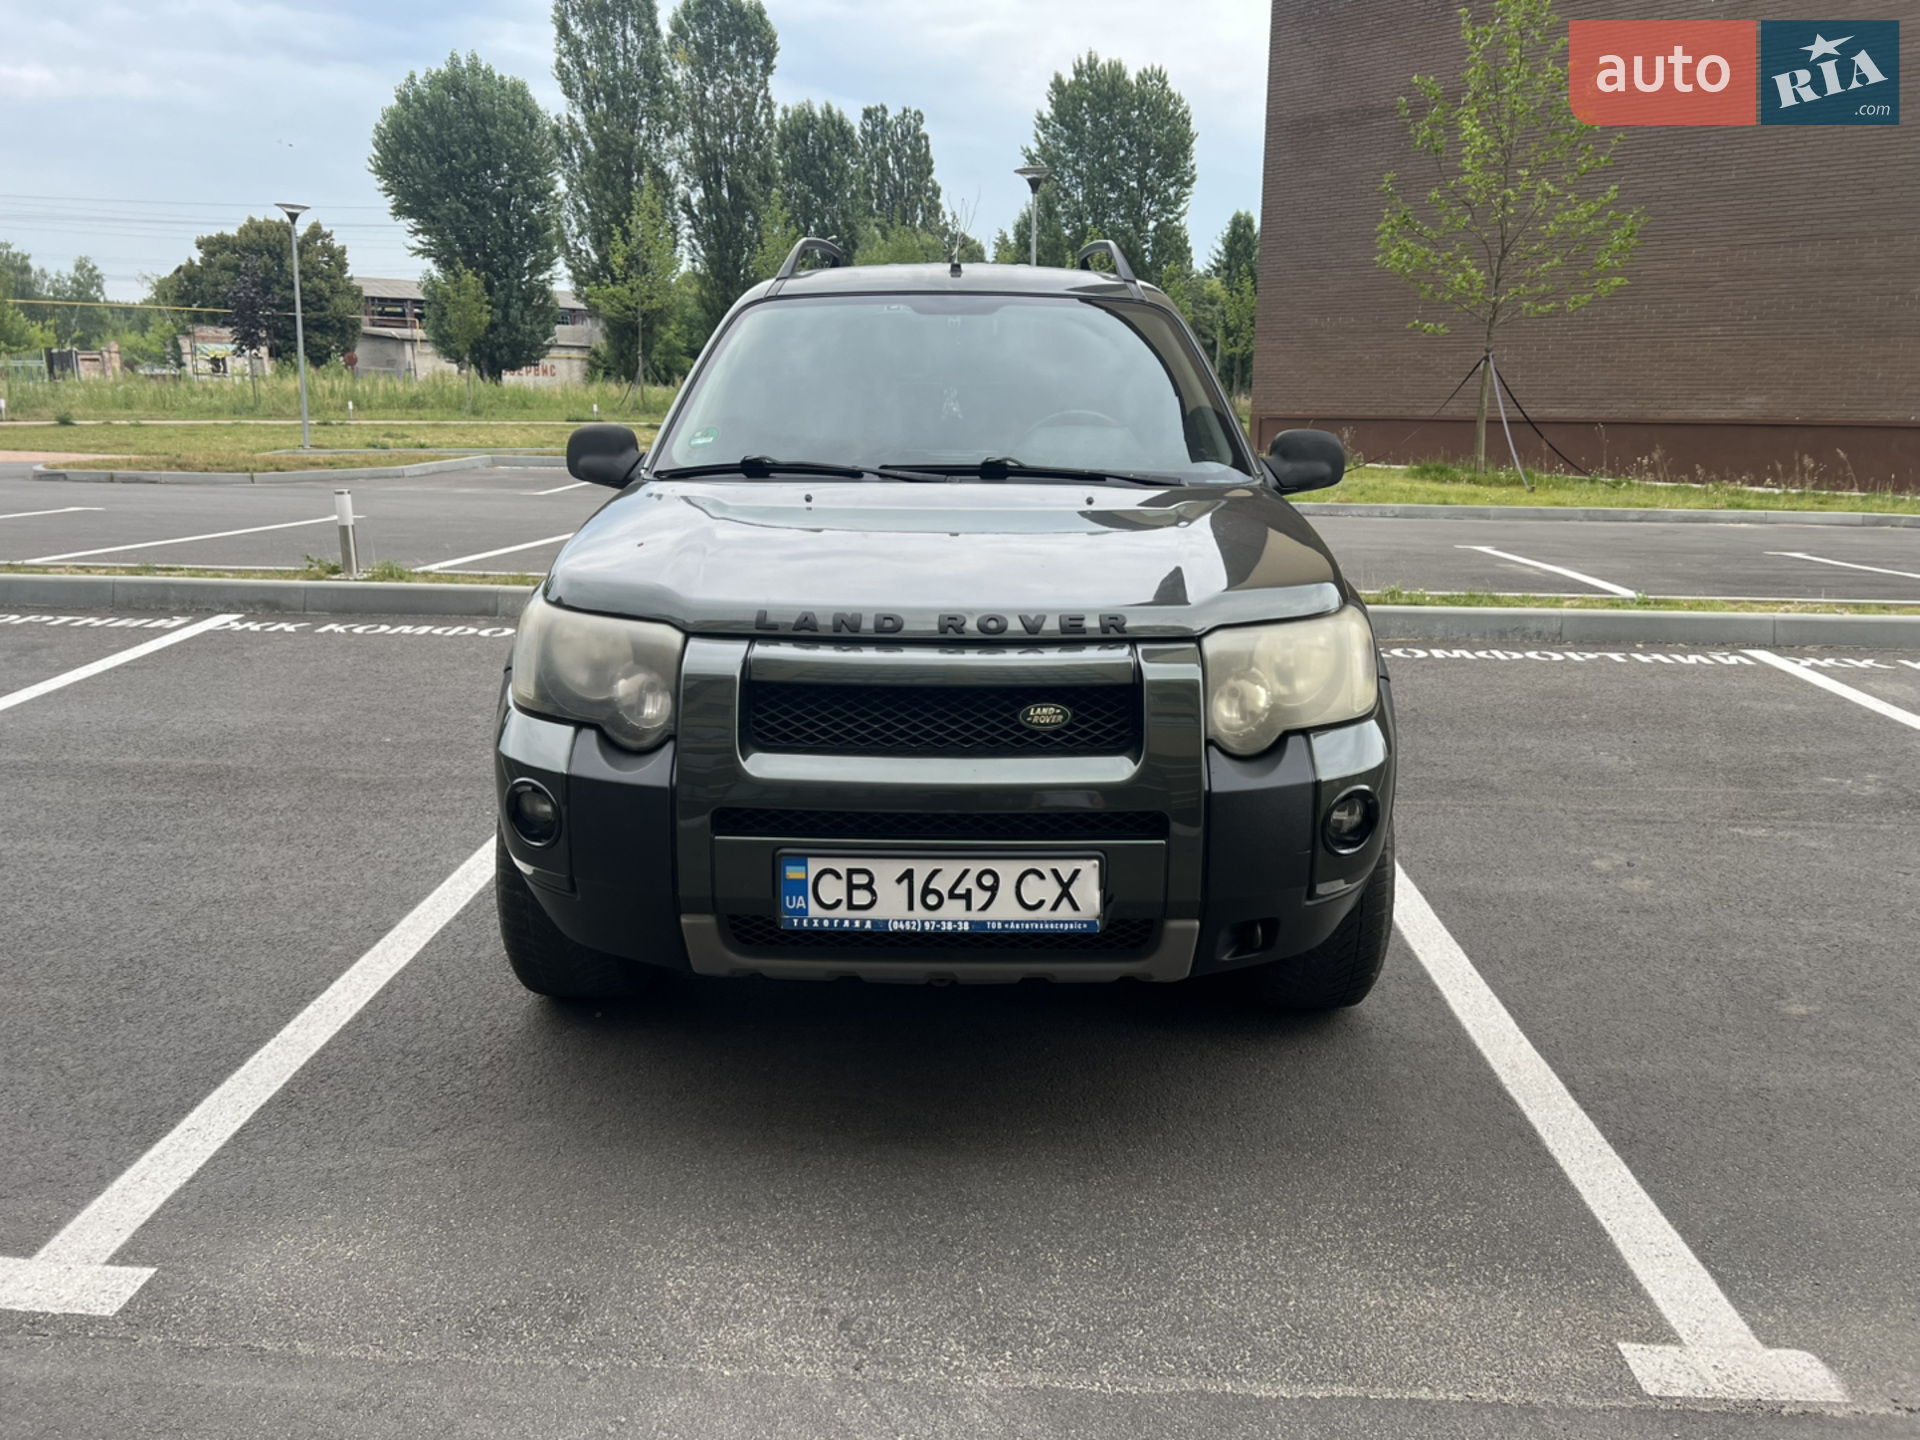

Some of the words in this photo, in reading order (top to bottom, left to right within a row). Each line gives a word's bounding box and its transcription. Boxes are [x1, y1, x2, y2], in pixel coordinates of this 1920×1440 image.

[502, 364, 557, 377] ЕРВИС
[754, 609, 905, 634] LAND
[937, 613, 1128, 635] ROVER
[314, 623, 517, 637] КОМФО
[811, 867, 878, 911] CB
[895, 867, 1001, 911] 1649
[1015, 867, 1082, 911] CX
[785, 895, 806, 910] UA
[924, 919, 970, 931] 97-38-38
